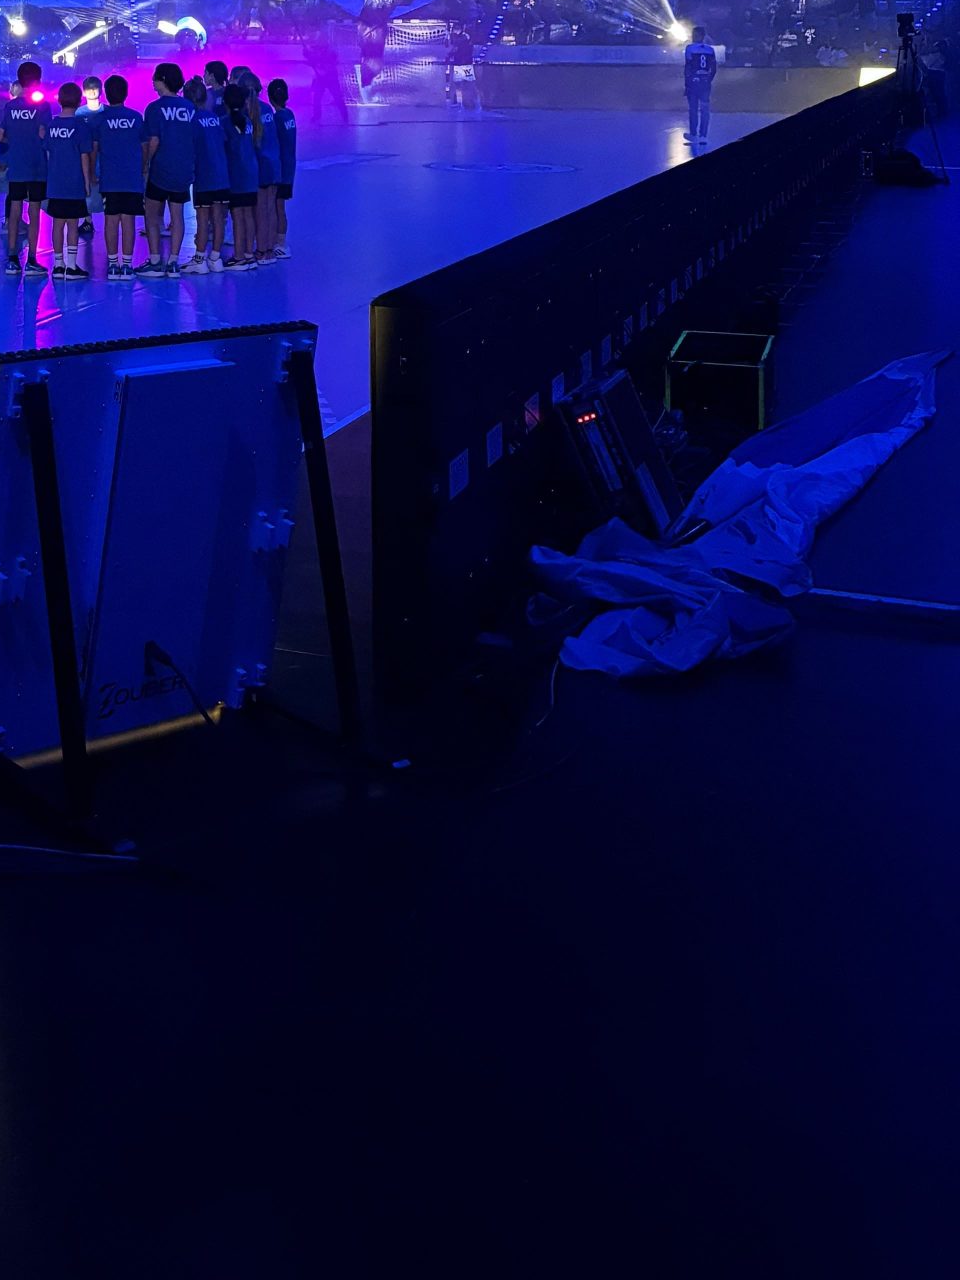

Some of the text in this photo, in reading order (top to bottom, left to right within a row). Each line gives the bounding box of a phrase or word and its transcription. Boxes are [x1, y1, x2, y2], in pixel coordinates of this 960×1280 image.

[700, 54, 707, 68] 8
[11, 109, 37, 120] WGV
[160, 107, 196, 122] WGV
[107, 118, 135, 129] WGV
[198, 117, 221, 128] WGV
[49, 127, 75, 139] WGV
